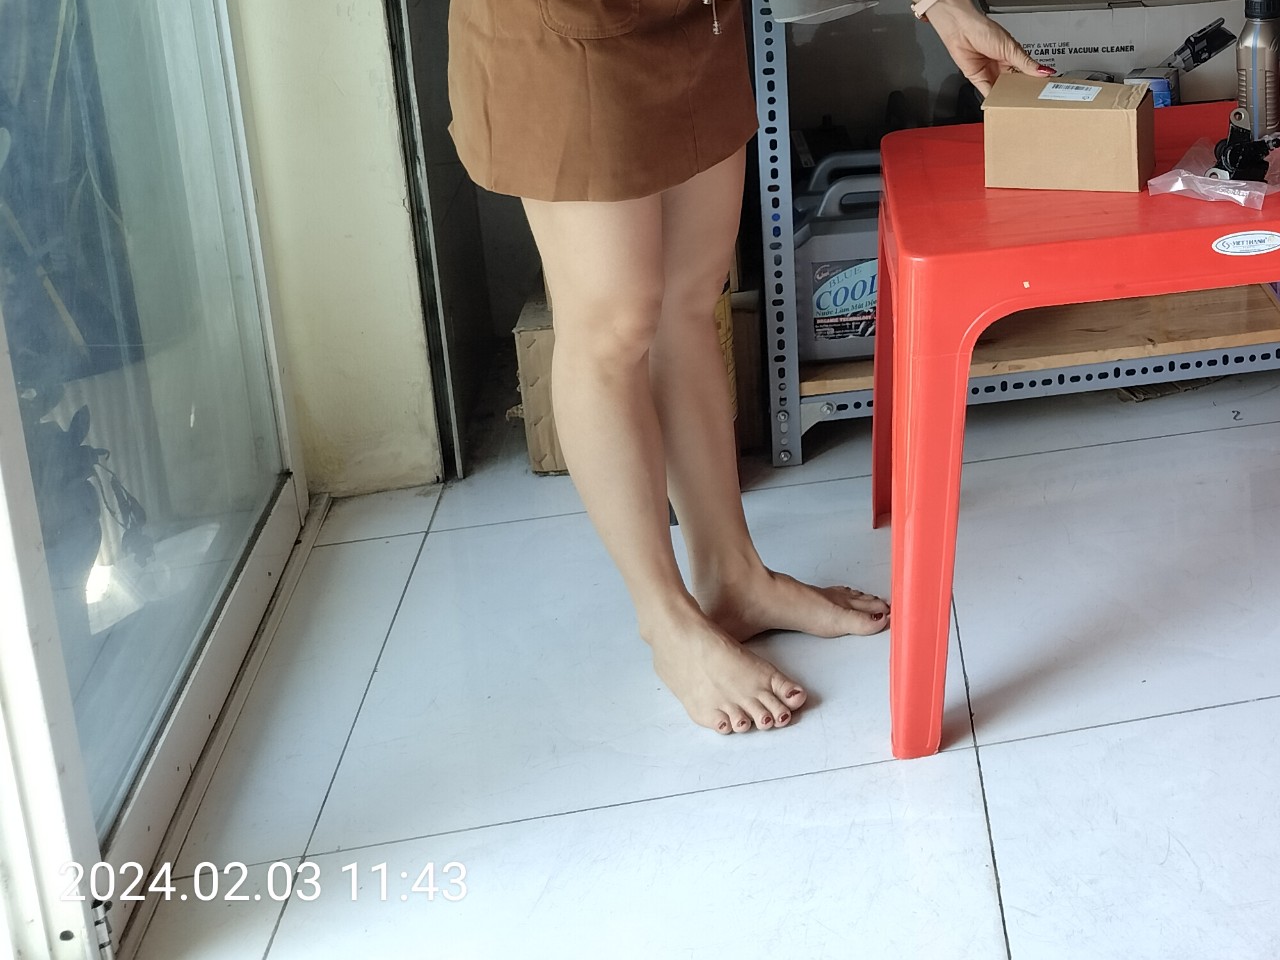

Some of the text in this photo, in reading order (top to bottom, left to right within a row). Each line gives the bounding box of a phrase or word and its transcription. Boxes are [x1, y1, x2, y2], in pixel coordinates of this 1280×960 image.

[1068, 46, 1100, 55] VACUUM
[1101, 45, 1135, 53] CLEANER
[829, 266, 862, 288] BLUE
